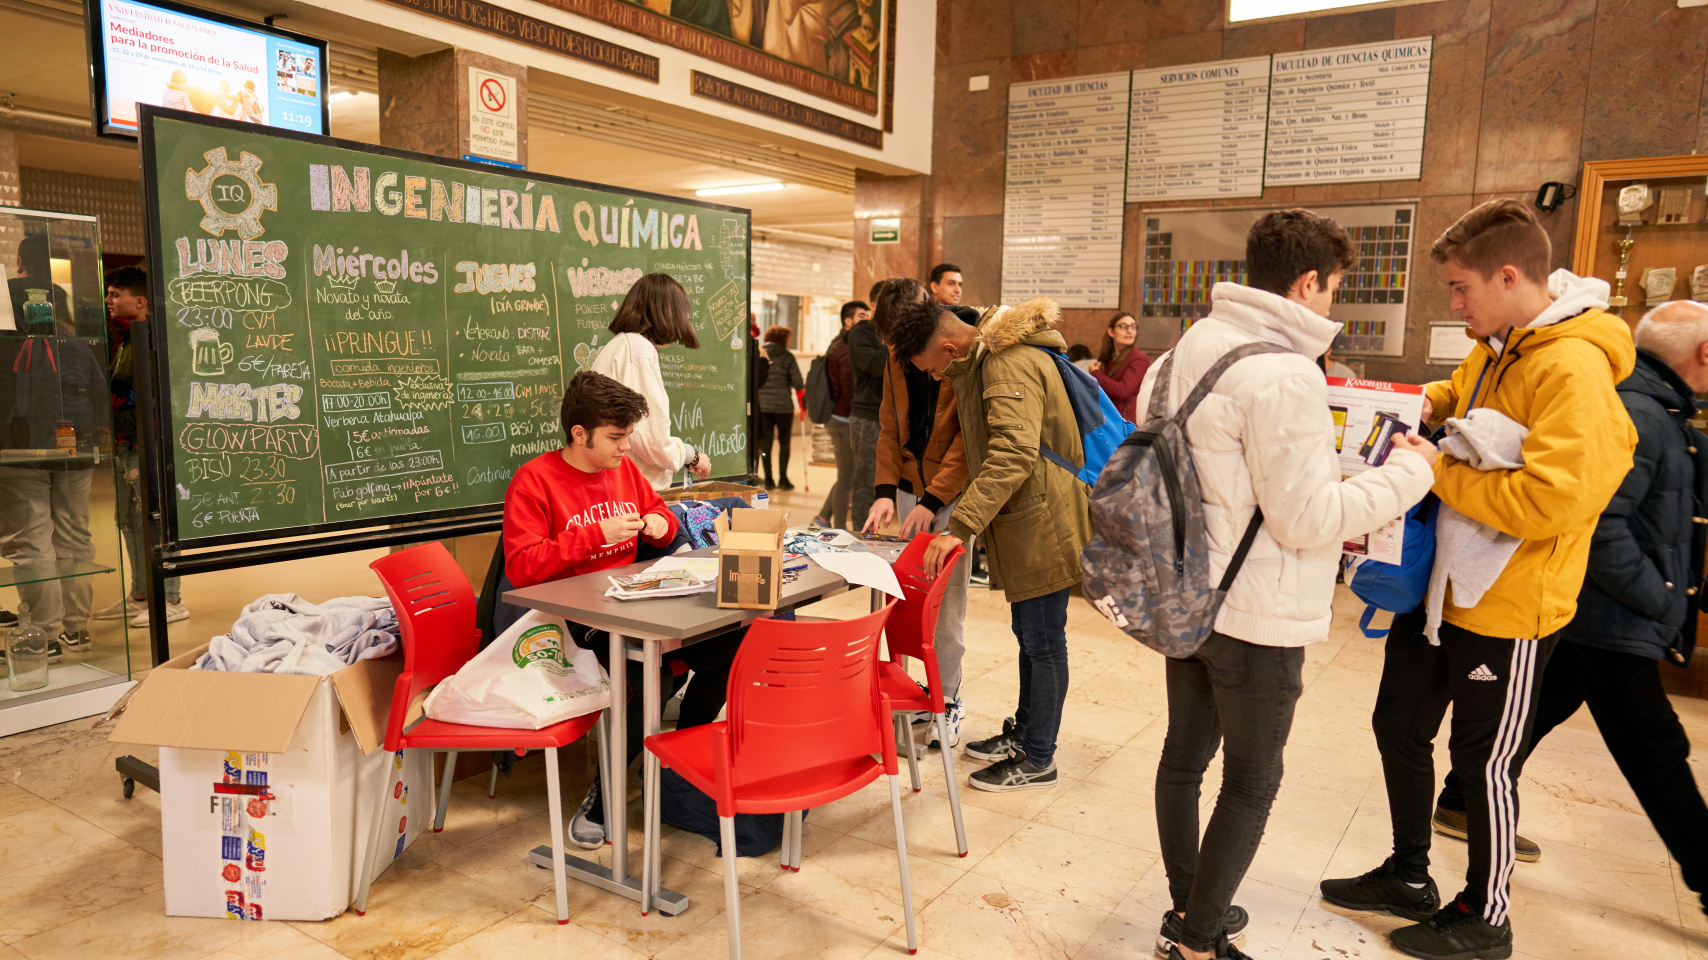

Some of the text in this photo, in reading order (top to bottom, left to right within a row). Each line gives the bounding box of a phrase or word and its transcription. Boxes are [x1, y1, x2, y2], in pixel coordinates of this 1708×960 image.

[110, 21, 175, 46] Mediadores
[111, 34, 258, 74] para la promoción de la Salud
[1276, 56, 1319, 72] FACULTAD
[1321, 54, 1334, 67] DE
[1336, 51, 1379, 66] CIENCIAS
[1160, 66, 1240, 85] SERVICIOS COMUNES
[1359, 79, 1376, 88] Textil
[1028, 81, 1109, 98] FACULTAD DE CIENCIAS
[281, 111, 312, 128] 11:19
[481, 117, 494, 126] ESTE
[496, 120, 516, 131] EDIFICIO
[480, 125, 491, 135] NO
[471, 133, 516, 149] PERMITIDO FUMAR
[1268, 147, 1304, 157] Departamento
[1267, 158, 1304, 169] Departamento
[1266, 170, 1303, 181] Departamento
[215, 184, 246, 203] IQ
[310, 163, 703, 251] INGENIERÍA QUÍMICA
[175, 236, 289, 280] LUNES
[313, 244, 439, 285] Miércoles
[454, 261, 537, 295] JUEVES
[693, 274, 705, 283] 8€
[316, 287, 412, 310] Novato y novata
[345, 308, 364, 321] del
[575, 303, 608, 315] POKER
[176, 307, 233, 330] 23:00
[334, 360, 381, 373] comida
[185, 381, 304, 423] MARTES
[400, 391, 411, 400] de
[462, 403, 471, 419] 2
[494, 403, 502, 417] 2
[530, 398, 548, 418] 5€
[323, 409, 425, 429] Verbena Atahualpa
[353, 429, 371, 444] 5€
[466, 426, 500, 441] 16:00
[356, 446, 372, 459] 6€
[329, 466, 338, 481] A
[339, 463, 371, 483] partir
[373, 462, 387, 474] de
[388, 459, 405, 471] las
[332, 486, 354, 500] Pub
[356, 482, 391, 501] golfing
[414, 488, 433, 504] por
[357, 499, 369, 511] por
[192, 506, 261, 528] 6€ PUERTA
[590, 541, 635, 561] MEMPHIS
[1467, 673, 1498, 681] adidas
